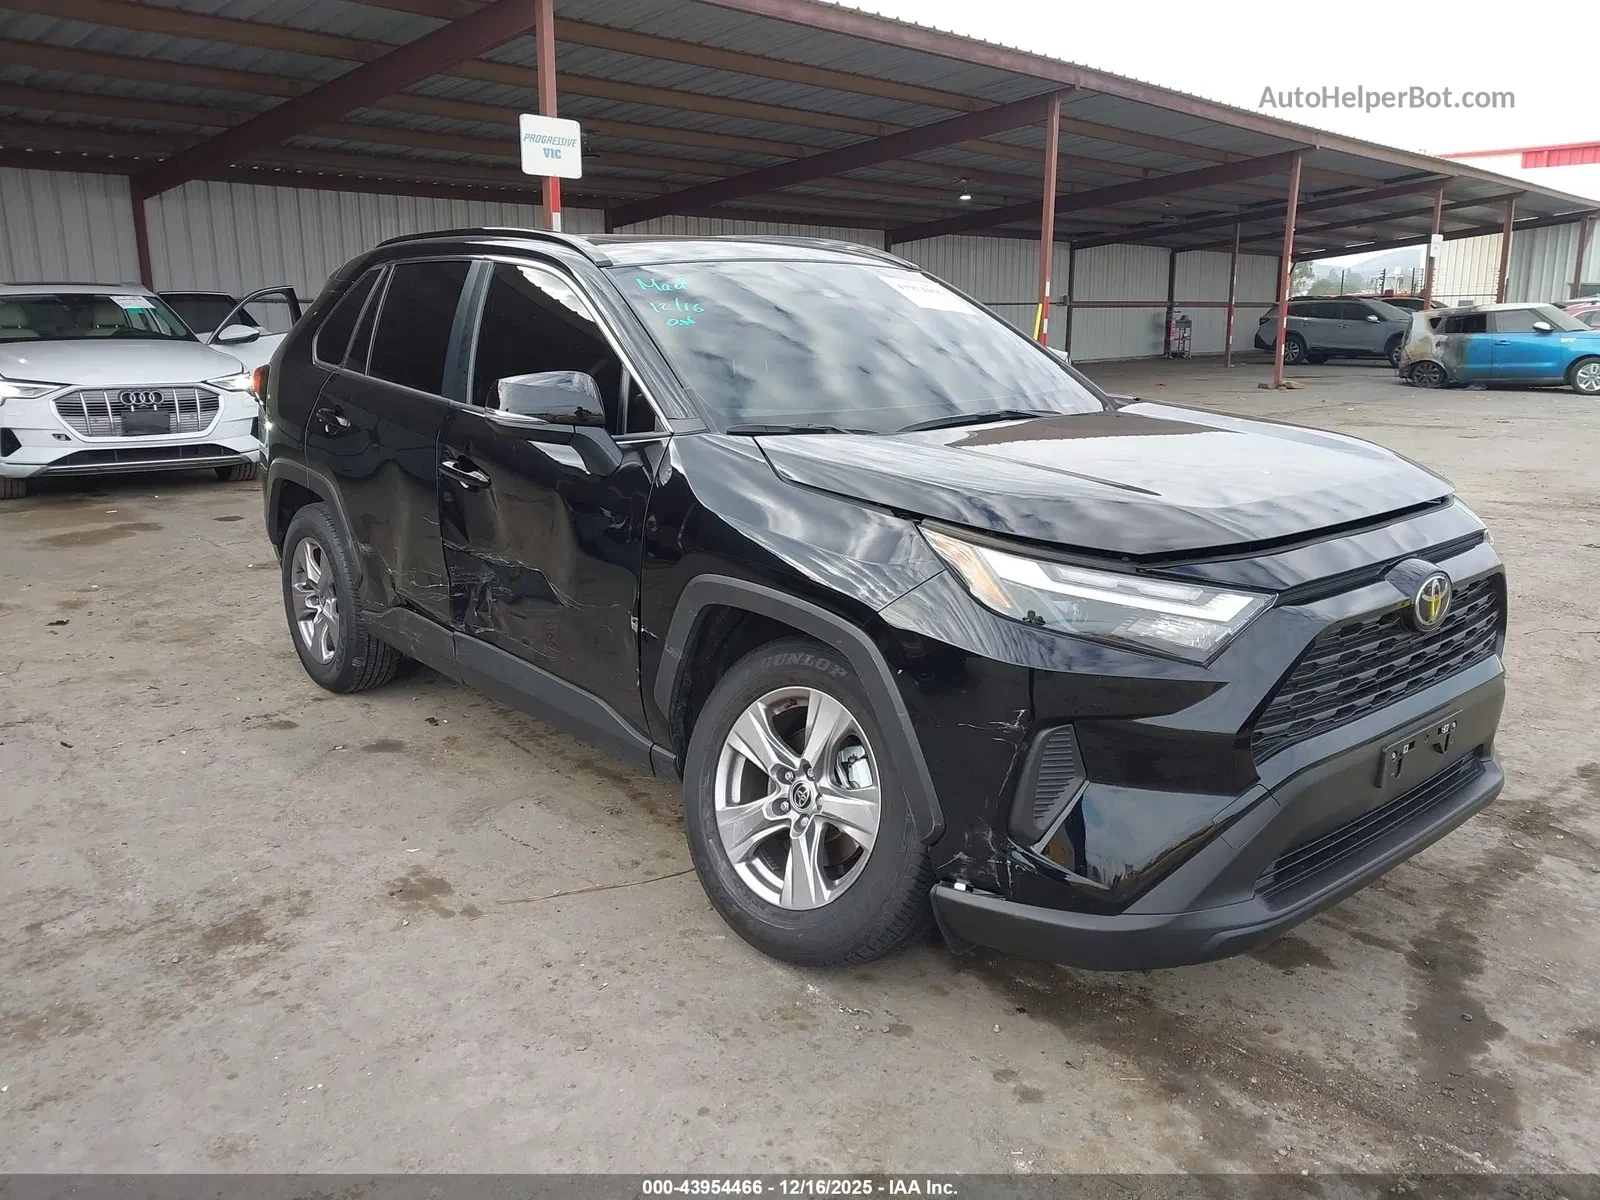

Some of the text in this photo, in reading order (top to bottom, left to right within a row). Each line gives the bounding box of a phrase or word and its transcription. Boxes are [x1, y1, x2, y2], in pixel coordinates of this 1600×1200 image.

[523, 132, 578, 148] PROGRESSIVE
[542, 147, 562, 160] VIC
[763, 652, 848, 677] DUNLOP
